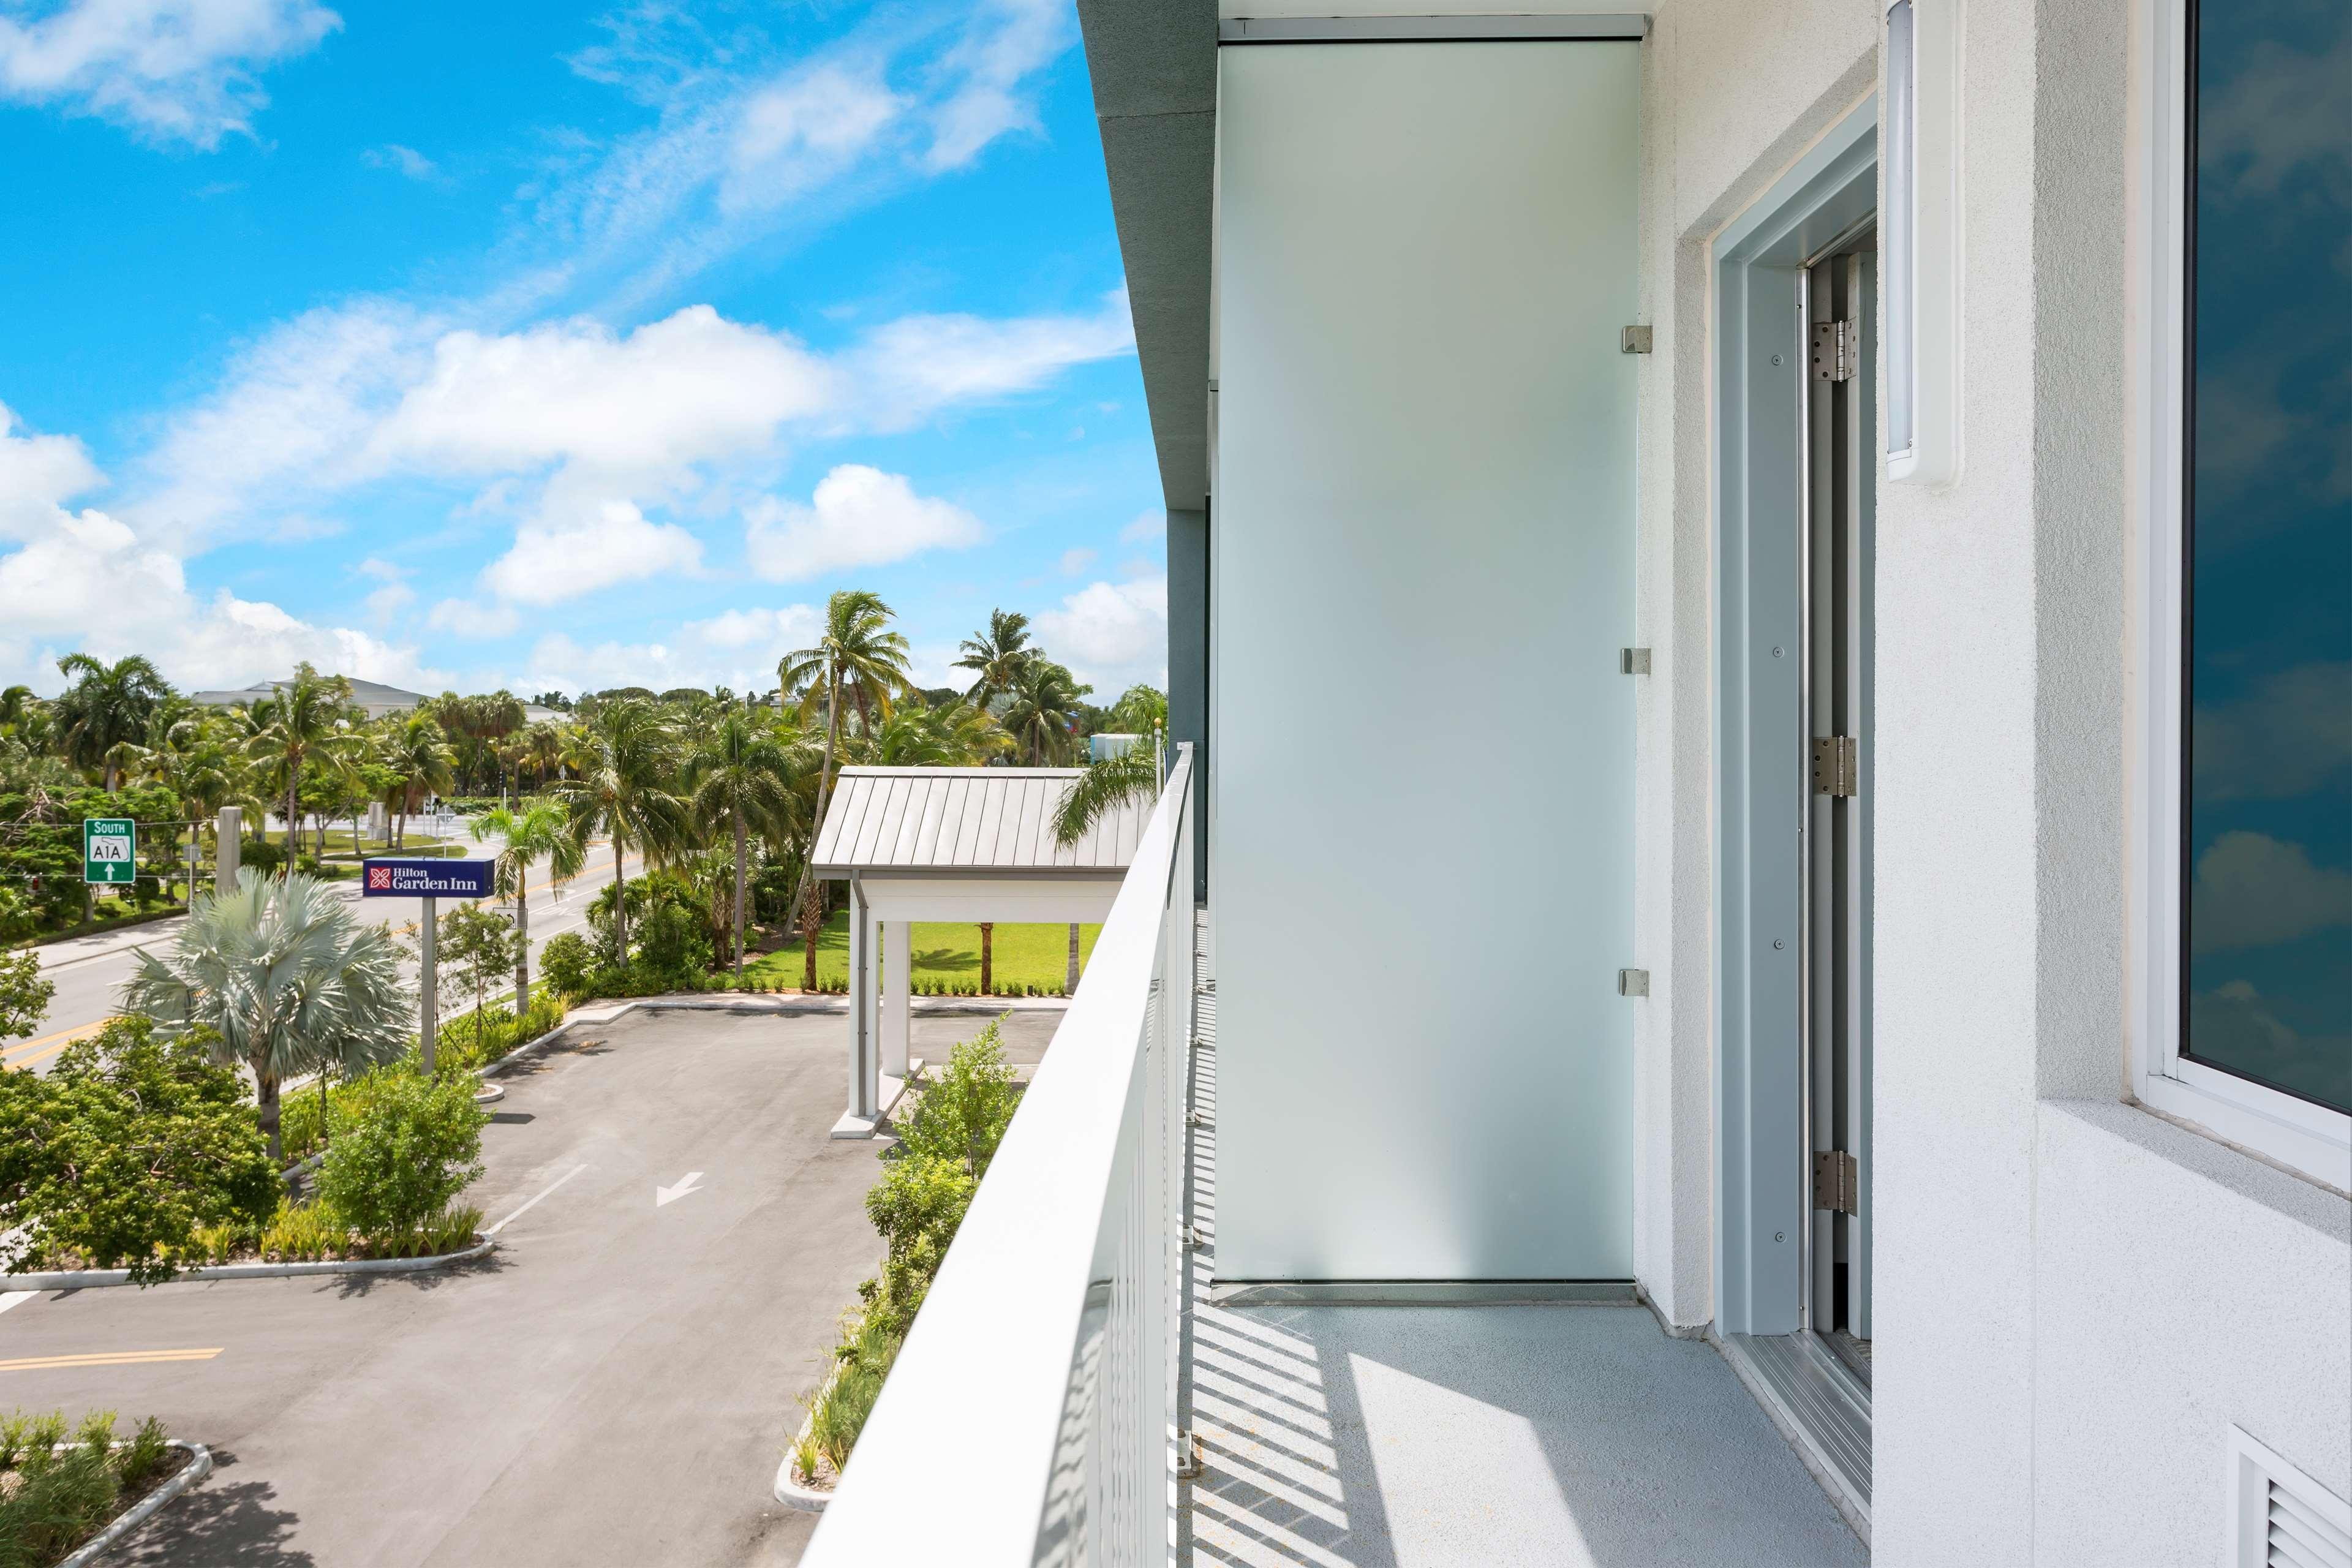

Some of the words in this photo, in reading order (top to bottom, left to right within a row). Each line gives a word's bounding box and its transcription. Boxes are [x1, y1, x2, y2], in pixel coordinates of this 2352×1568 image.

[94, 821, 125, 834] SOUTH
[94, 845, 121, 859] A1A
[393, 868, 427, 877] Hilton
[392, 877, 447, 889] Garden
[450, 877, 477, 890] Inn
